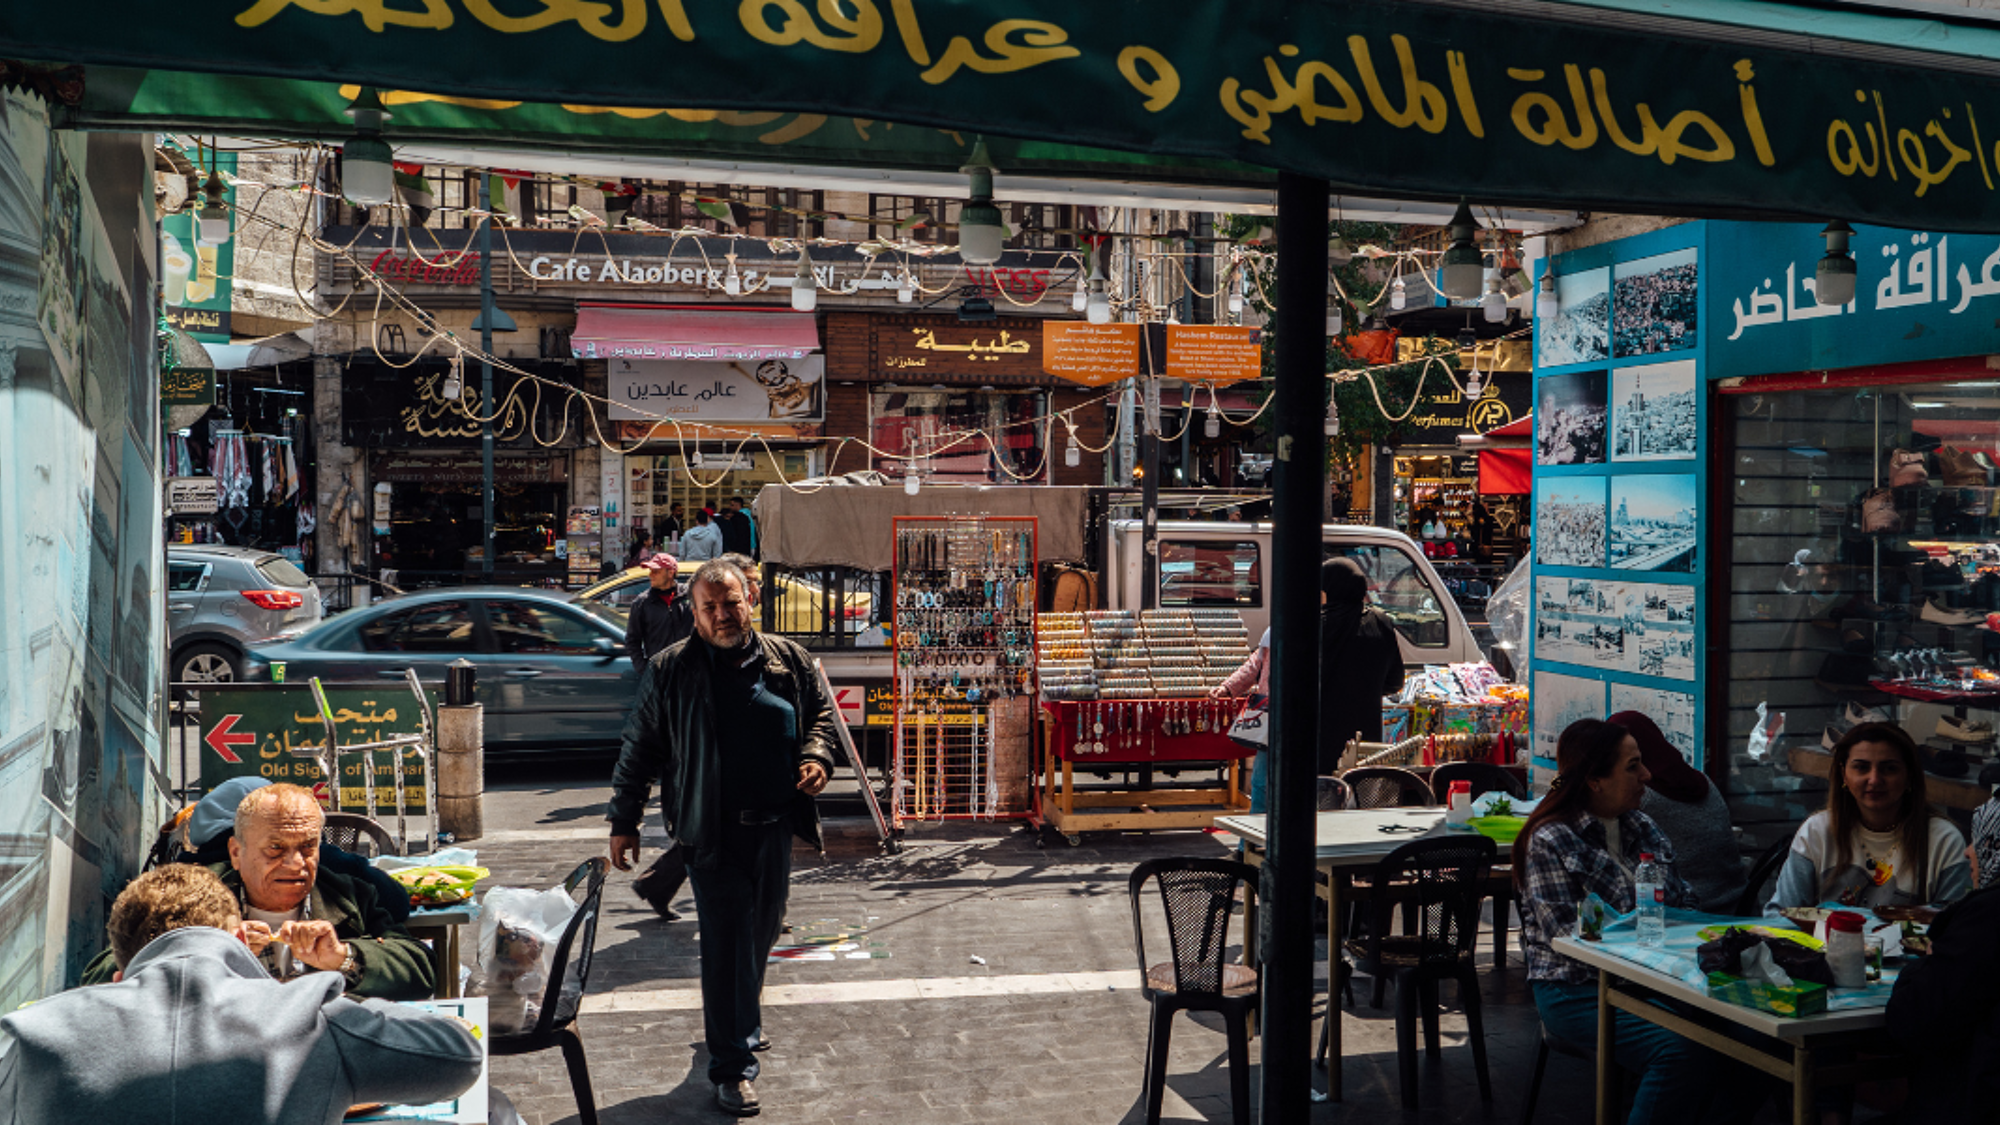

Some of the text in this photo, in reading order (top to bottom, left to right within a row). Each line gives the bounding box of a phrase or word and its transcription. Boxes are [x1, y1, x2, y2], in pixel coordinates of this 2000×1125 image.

[530, 256, 724, 290] Cafe Alaoberg
[1209, 331, 1250, 341] Restauran
[627, 380, 738, 401] عالم عابدين
[260, 763, 289, 776] Old
[294, 763, 340, 779] Sig
[345, 762, 363, 776] of
